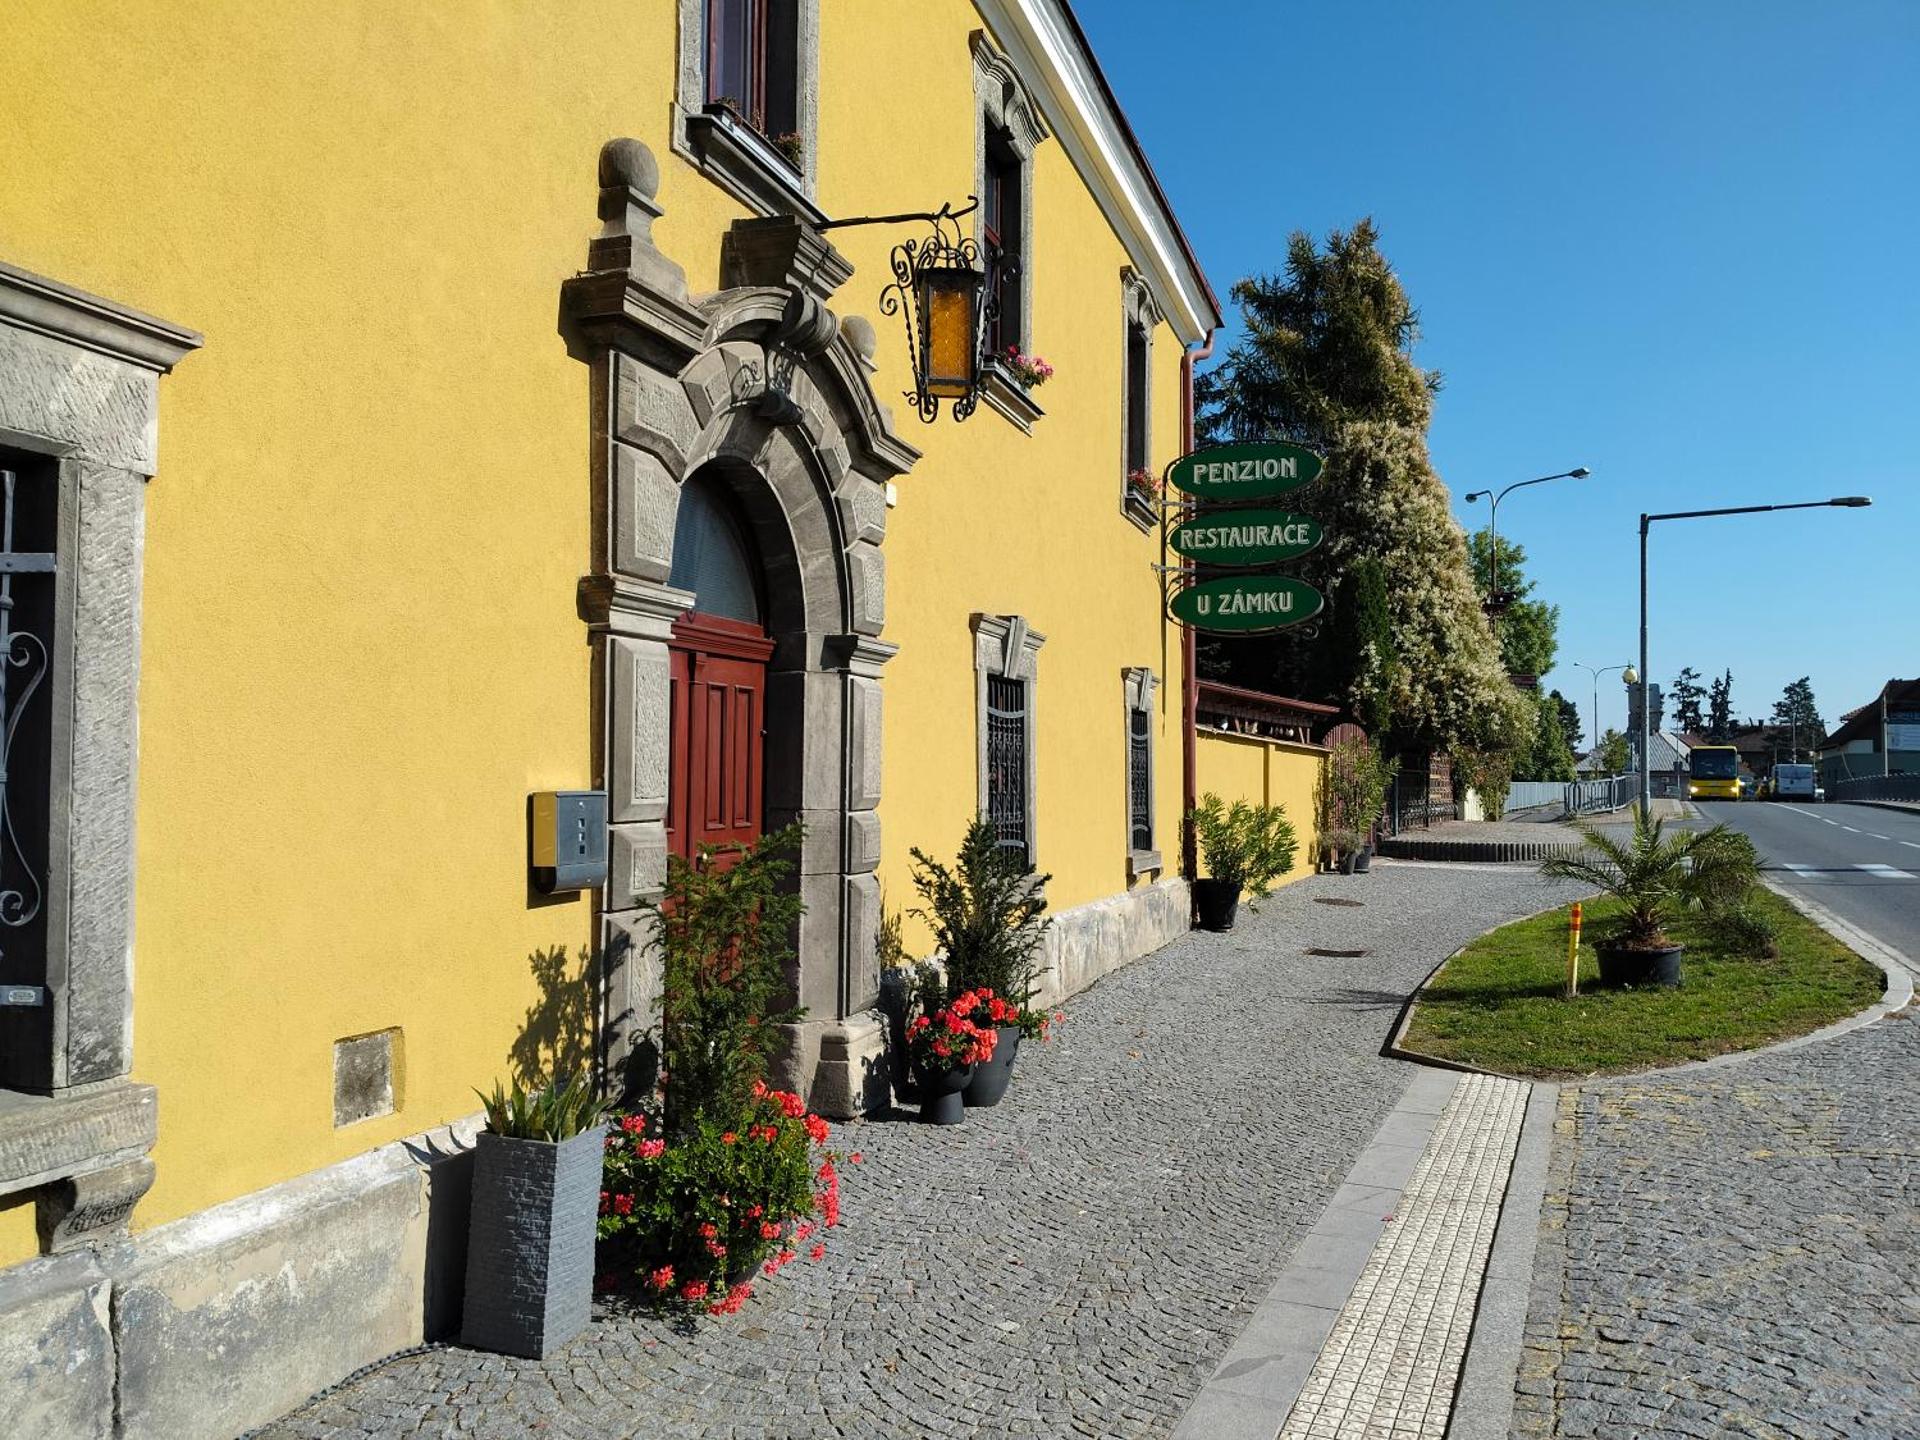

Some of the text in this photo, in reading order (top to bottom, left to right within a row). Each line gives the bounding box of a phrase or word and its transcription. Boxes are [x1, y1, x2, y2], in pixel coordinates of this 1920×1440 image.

[1193, 457, 1297, 485] PENZION
[1197, 589, 1294, 616] U ZÁMKU
